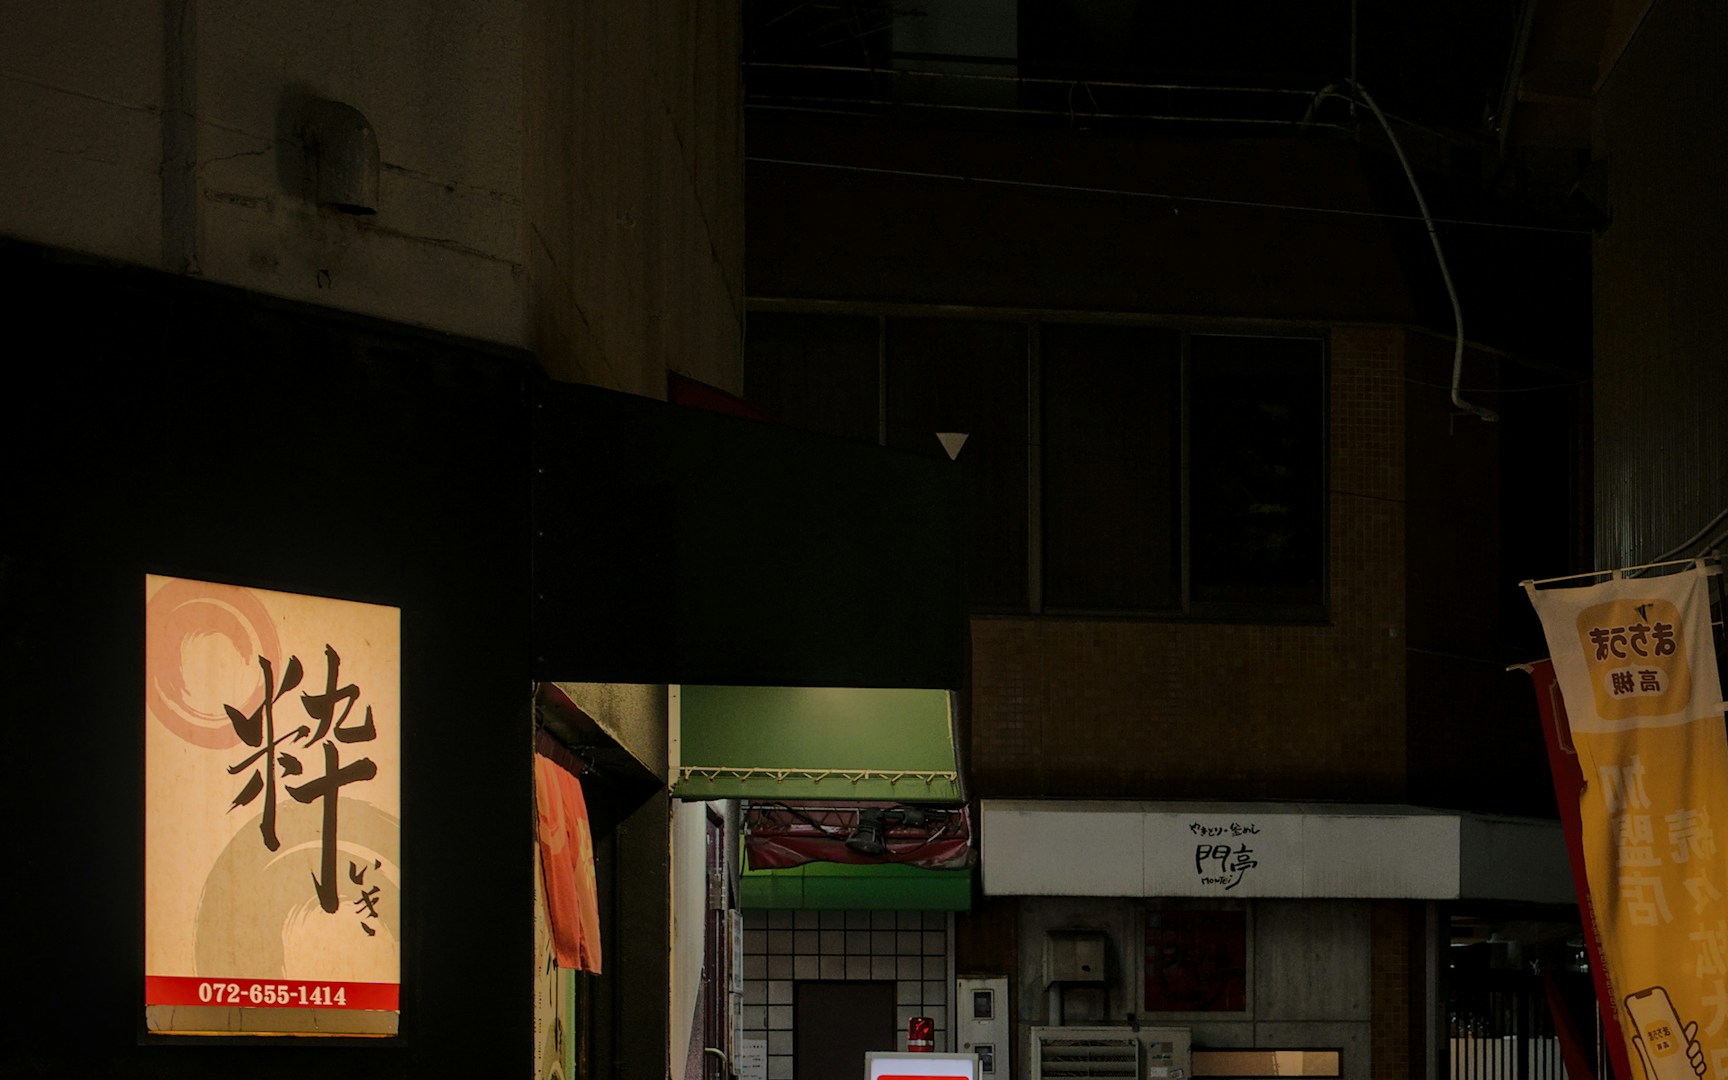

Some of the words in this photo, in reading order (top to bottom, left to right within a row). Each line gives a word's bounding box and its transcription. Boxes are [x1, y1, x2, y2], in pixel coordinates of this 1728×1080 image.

[223, 643, 377, 913] 粋
[348, 858, 381, 936] いき
[1196, 843, 1258, 890] 門亭
[198, 982, 347, 1007] 072-655-1414
